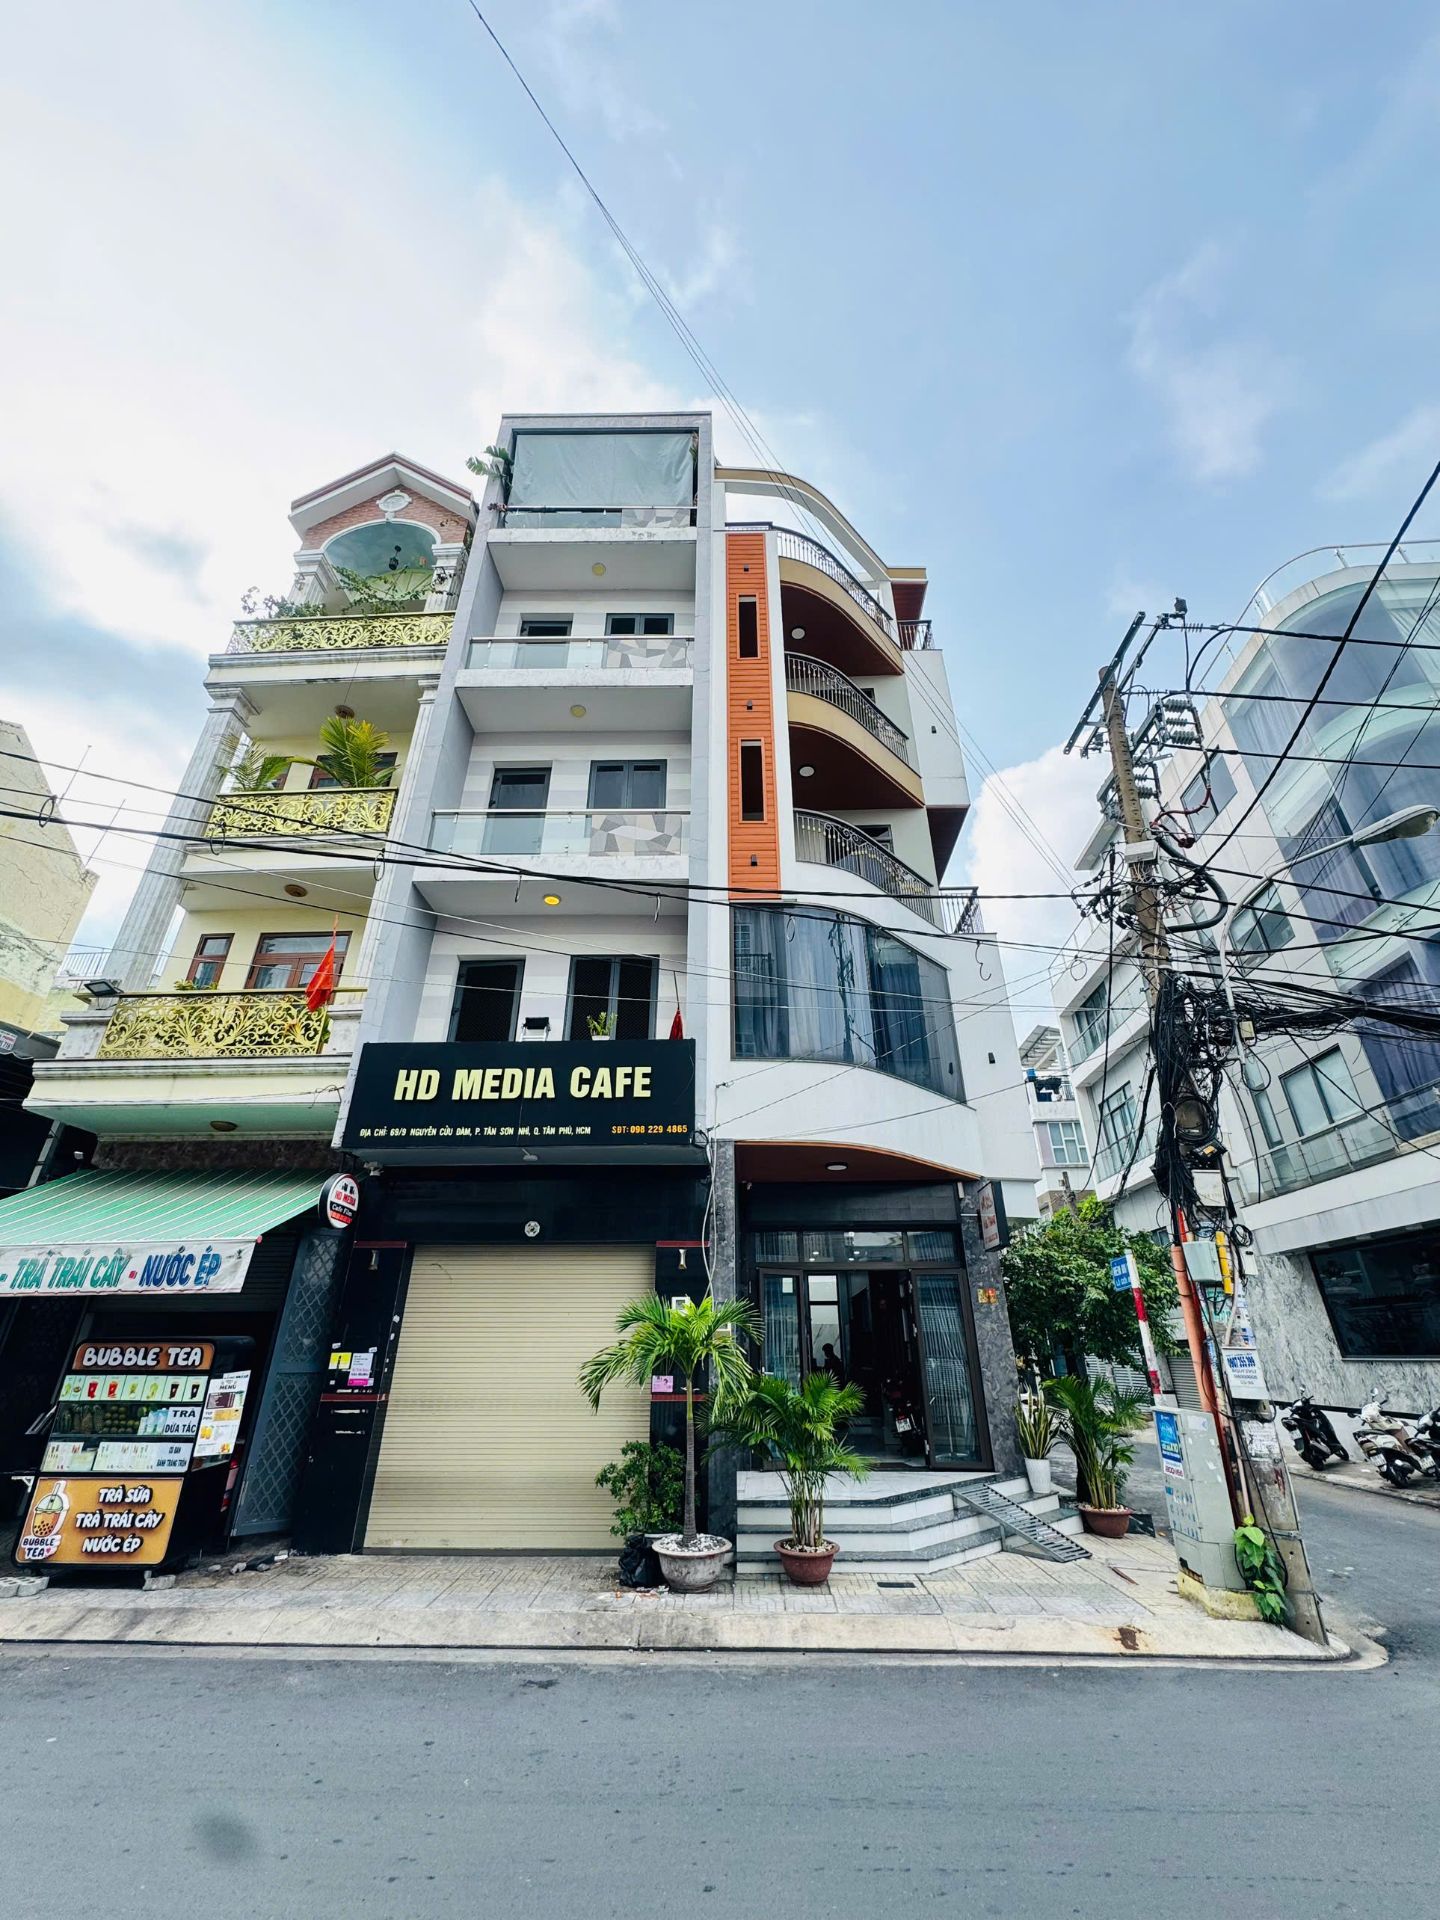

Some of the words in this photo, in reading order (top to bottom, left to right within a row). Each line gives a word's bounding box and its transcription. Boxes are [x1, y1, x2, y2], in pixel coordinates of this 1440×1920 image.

[393, 1069, 441, 1101] HD
[451, 1067, 556, 1100] MEDIA
[569, 1066, 652, 1099] CAFE
[390, 1127, 407, 1137] 69/9
[410, 1125, 437, 1136] NGUYỄN
[475, 1127, 482, 1136] P.
[484, 1126, 497, 1136] TÂN
[534, 1127, 541, 1136] Q.
[543, 1125, 556, 1136] TÂN
[576, 1126, 591, 1135] HCM
[630, 1125, 646, 1134] 098
[648, 1125, 664, 1134] 229
[667, 1124, 688, 1134] 4865
[48, 1248, 95, 1288] TRÁI
[90, 1247, 132, 1288] CÂY
[139, 1245, 196, 1287] NƯỚC
[194, 1245, 222, 1286] ÉP
[83, 1347, 160, 1366] BUBBLE
[168, 1347, 202, 1366] TEA
[172, 1408, 196, 1418] TRÀ
[99, 1486, 124, 1502] TRÀ
[125, 1486, 151, 1502] SỮA
[75, 1510, 101, 1528] TRÀ
[103, 1510, 134, 1528] TRÁI
[134, 1510, 163, 1528] CÂY
[23, 1538, 56, 1546] BUBBLE
[82, 1535, 121, 1553] NƯỚC
[122, 1534, 141, 1553] ÉP
[26, 1548, 45, 1557] TEA
